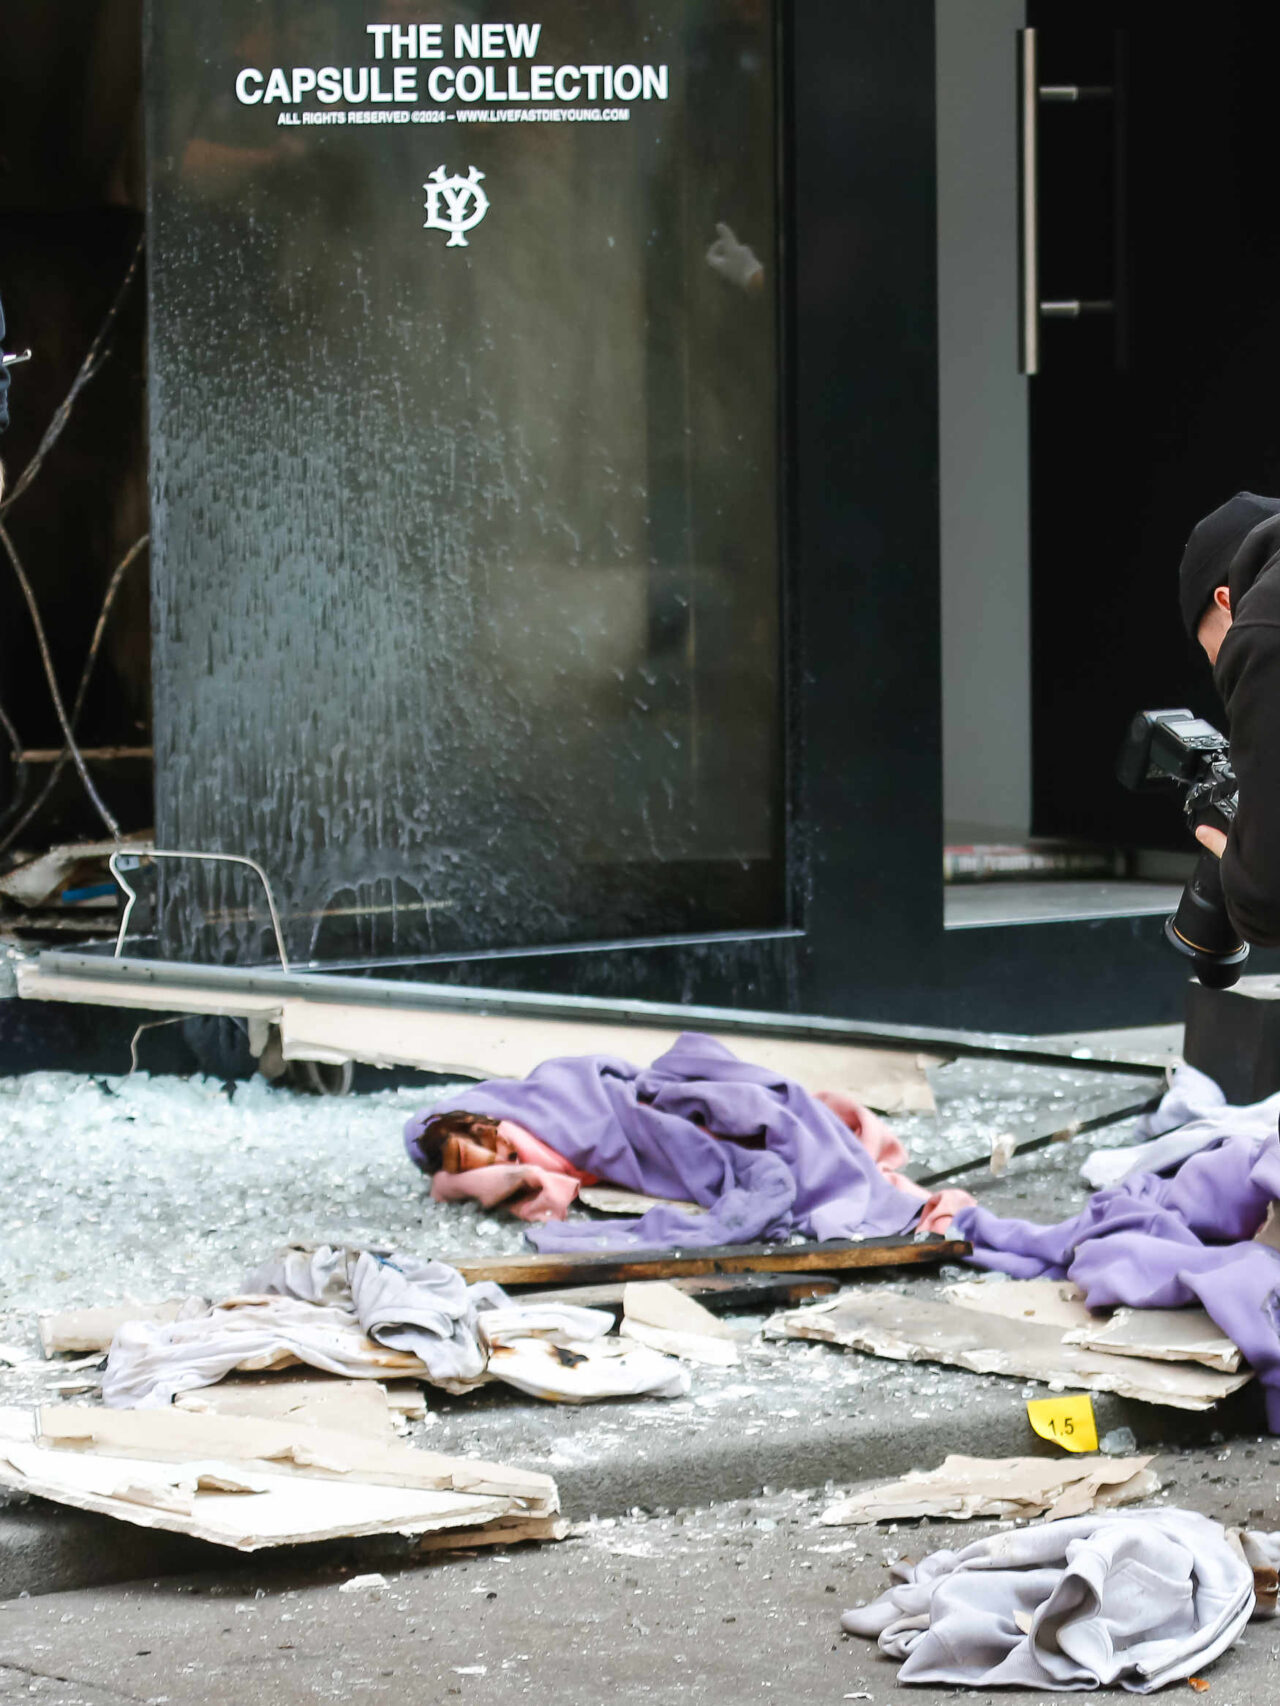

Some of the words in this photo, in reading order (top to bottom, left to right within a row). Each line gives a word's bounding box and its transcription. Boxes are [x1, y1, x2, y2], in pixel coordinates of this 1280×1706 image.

[366, 24, 443, 59] THE
[454, 23, 541, 58] NEW
[235, 67, 418, 105] CAPSULE
[428, 64, 669, 102] COLLECTION
[277, 112, 301, 125] ALL
[302, 111, 347, 125] RIGHTS
[348, 110, 411, 124] RESERVED
[456, 108, 630, 122] WWW.LIVEFASTDIEYOUNG.COM
